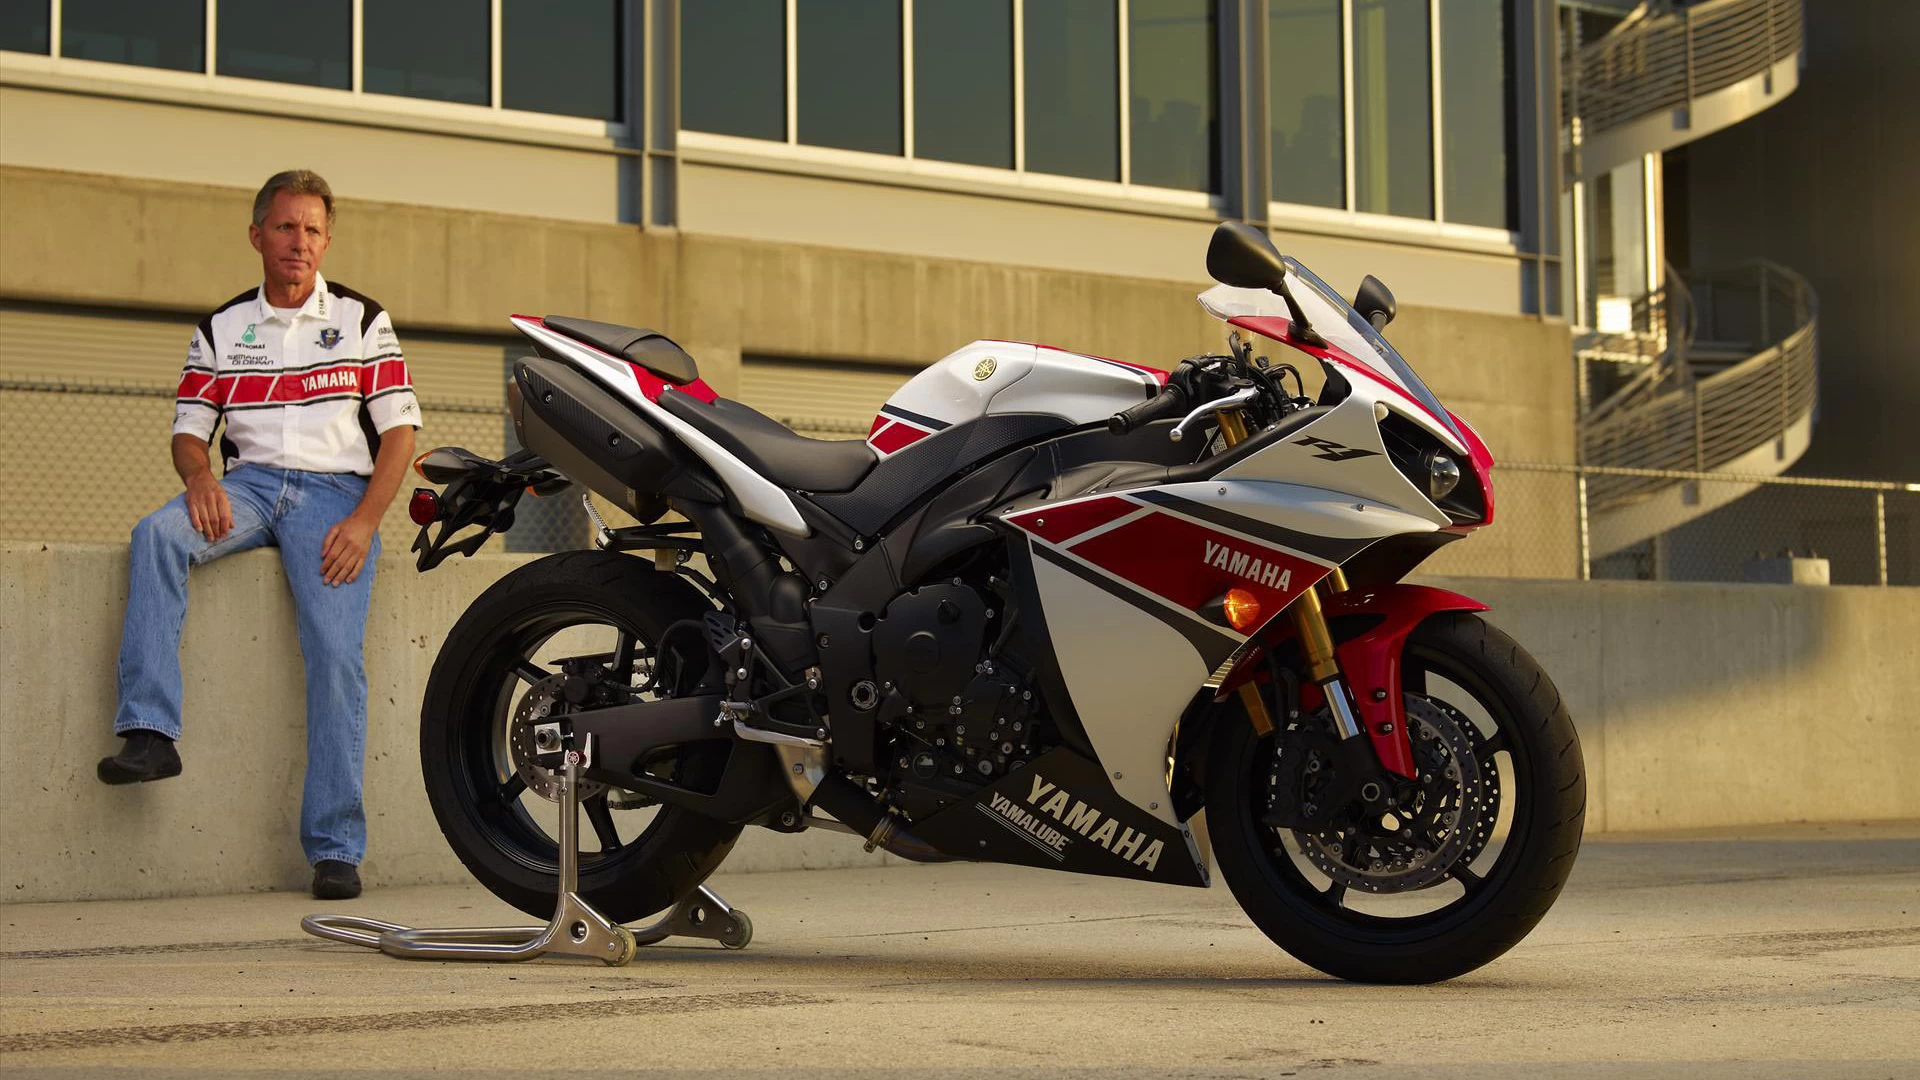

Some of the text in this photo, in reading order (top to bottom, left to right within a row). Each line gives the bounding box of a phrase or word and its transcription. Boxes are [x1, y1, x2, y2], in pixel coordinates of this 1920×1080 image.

[301, 371, 357, 392] YAMAHA
[1203, 540, 1291, 592] YAMAHA
[989, 791, 1070, 851] YAMALUBE
[1026, 774, 1164, 872] YAMAHA
